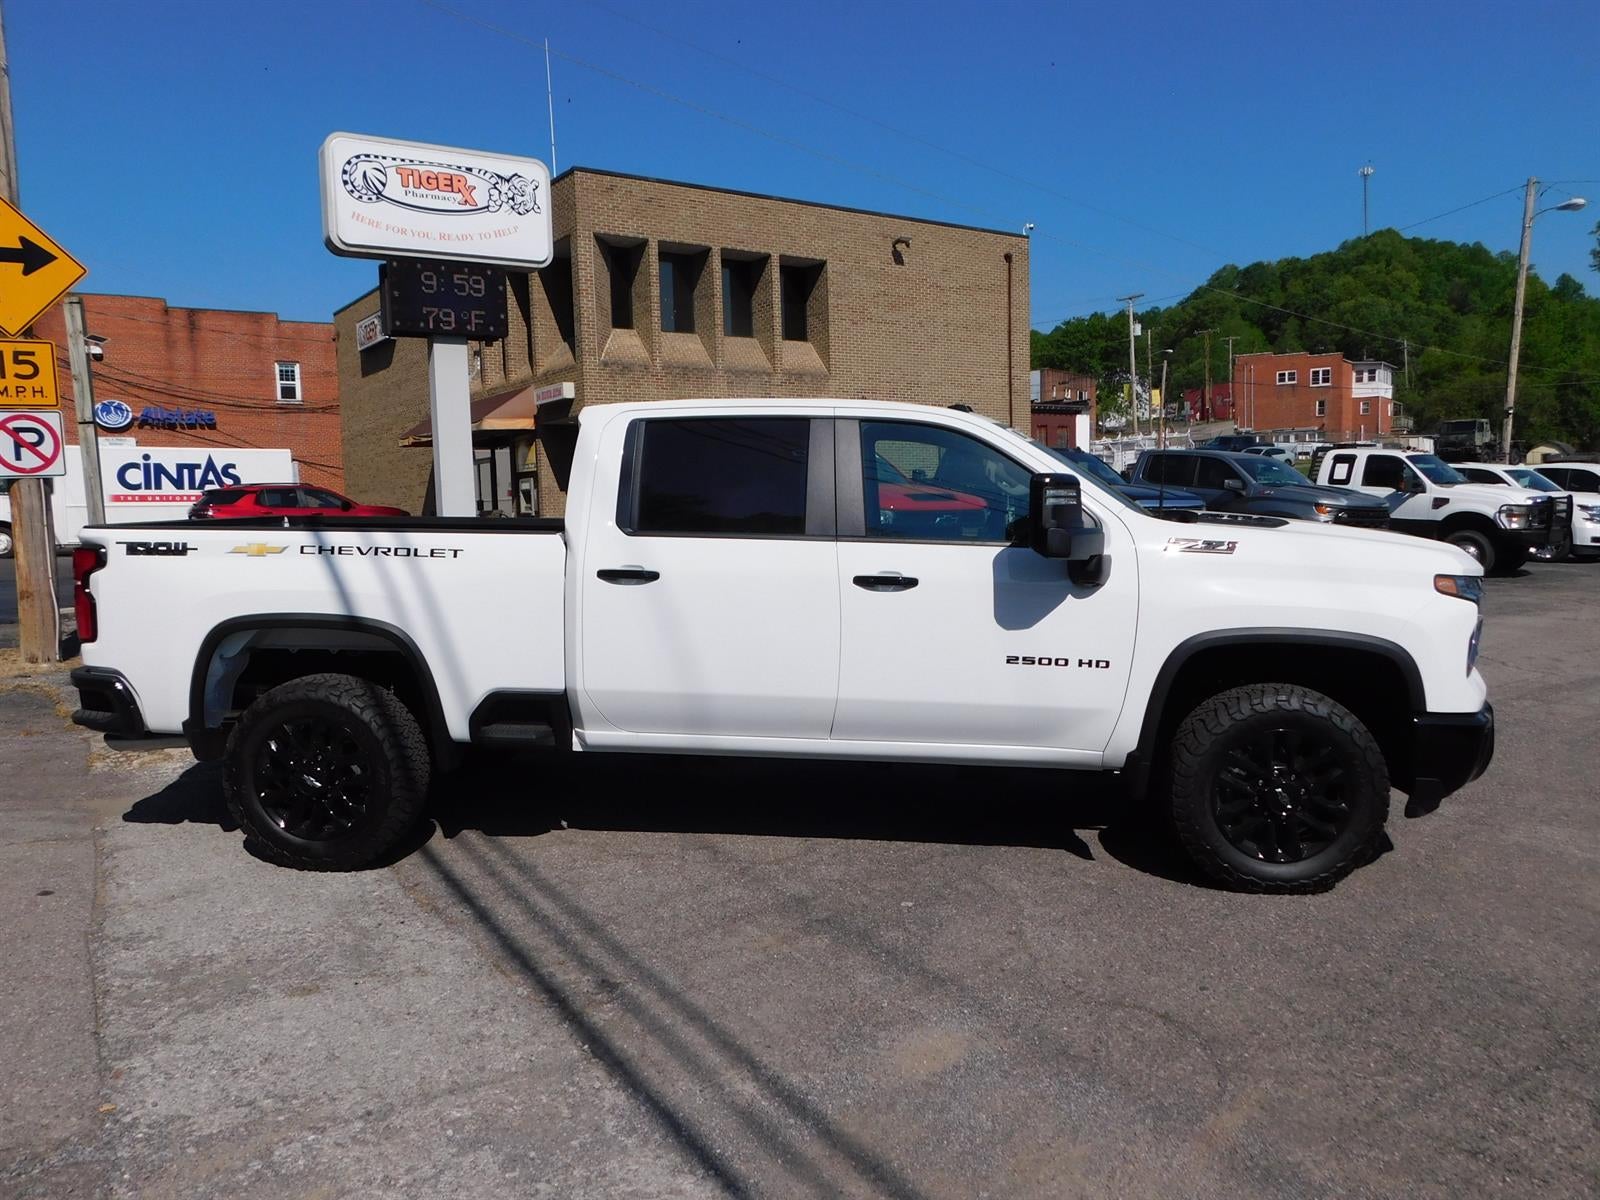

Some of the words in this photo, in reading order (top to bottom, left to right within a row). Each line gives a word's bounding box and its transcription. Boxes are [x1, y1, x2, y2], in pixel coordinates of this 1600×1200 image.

[404, 189, 458, 203] Pharmacy
[351, 211, 382, 229] HERE
[385, 223, 408, 236] FOR
[438, 232, 475, 241] READY
[479, 231, 492, 241] TO
[494, 224, 520, 238] HELP
[421, 271, 485, 297] 9:59
[140, 406, 217, 425] Allstate
[299, 545, 464, 559] CHEVROLET
[1006, 655, 1069, 667] 2500
[1078, 658, 1111, 669] HD
